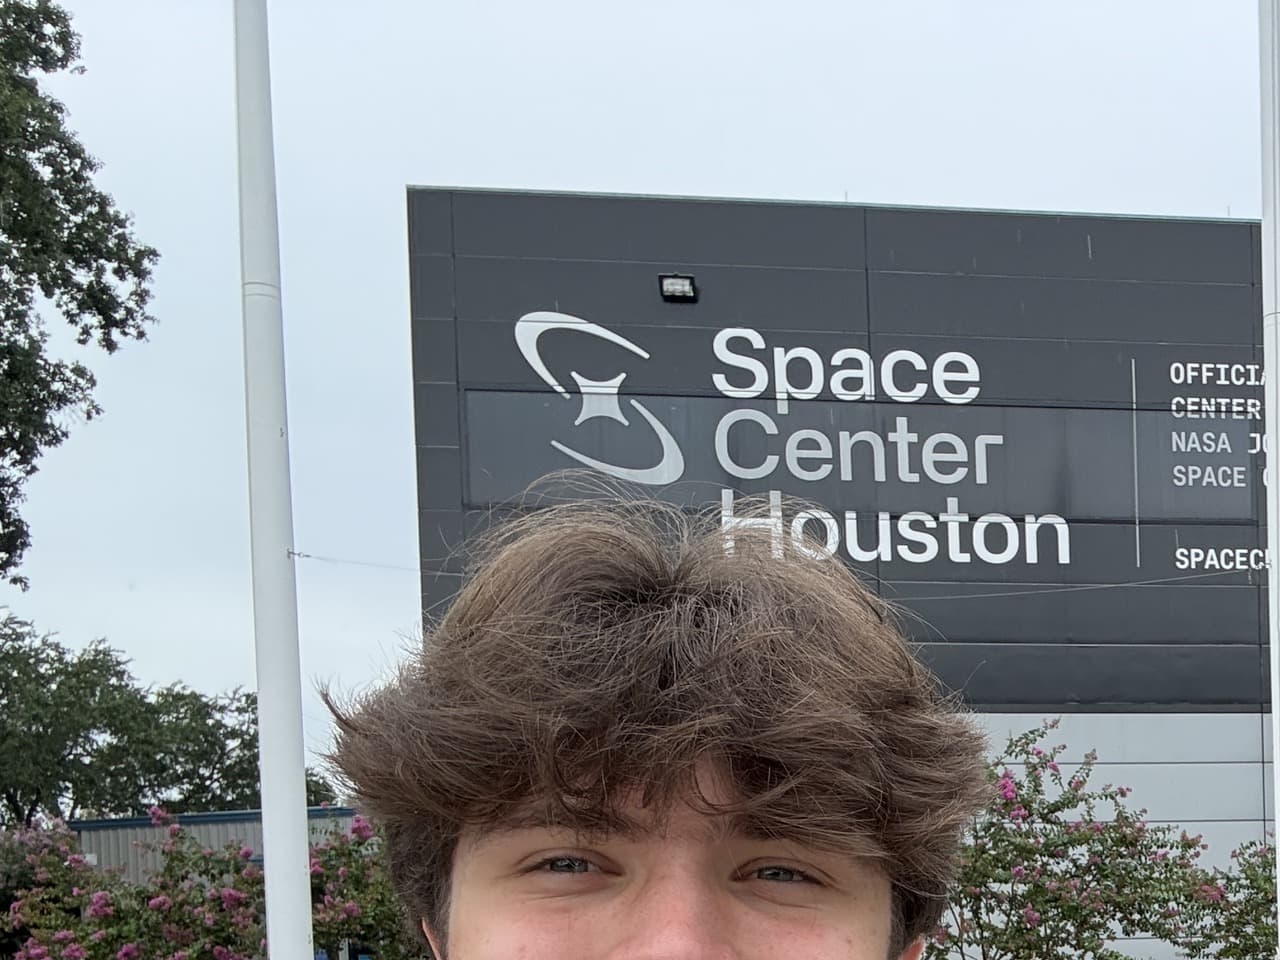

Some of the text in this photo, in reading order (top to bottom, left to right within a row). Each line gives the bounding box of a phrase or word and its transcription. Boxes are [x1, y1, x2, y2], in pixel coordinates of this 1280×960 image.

[712, 328, 981, 414] Space
[1170, 362, 1266, 385] OFFICI
[1170, 397, 1262, 420] CENTER
[714, 408, 1003, 485] Center
[1171, 431, 1232, 453] NASA
[1173, 465, 1246, 488] SPACE
[721, 489, 1070, 564] Houston
